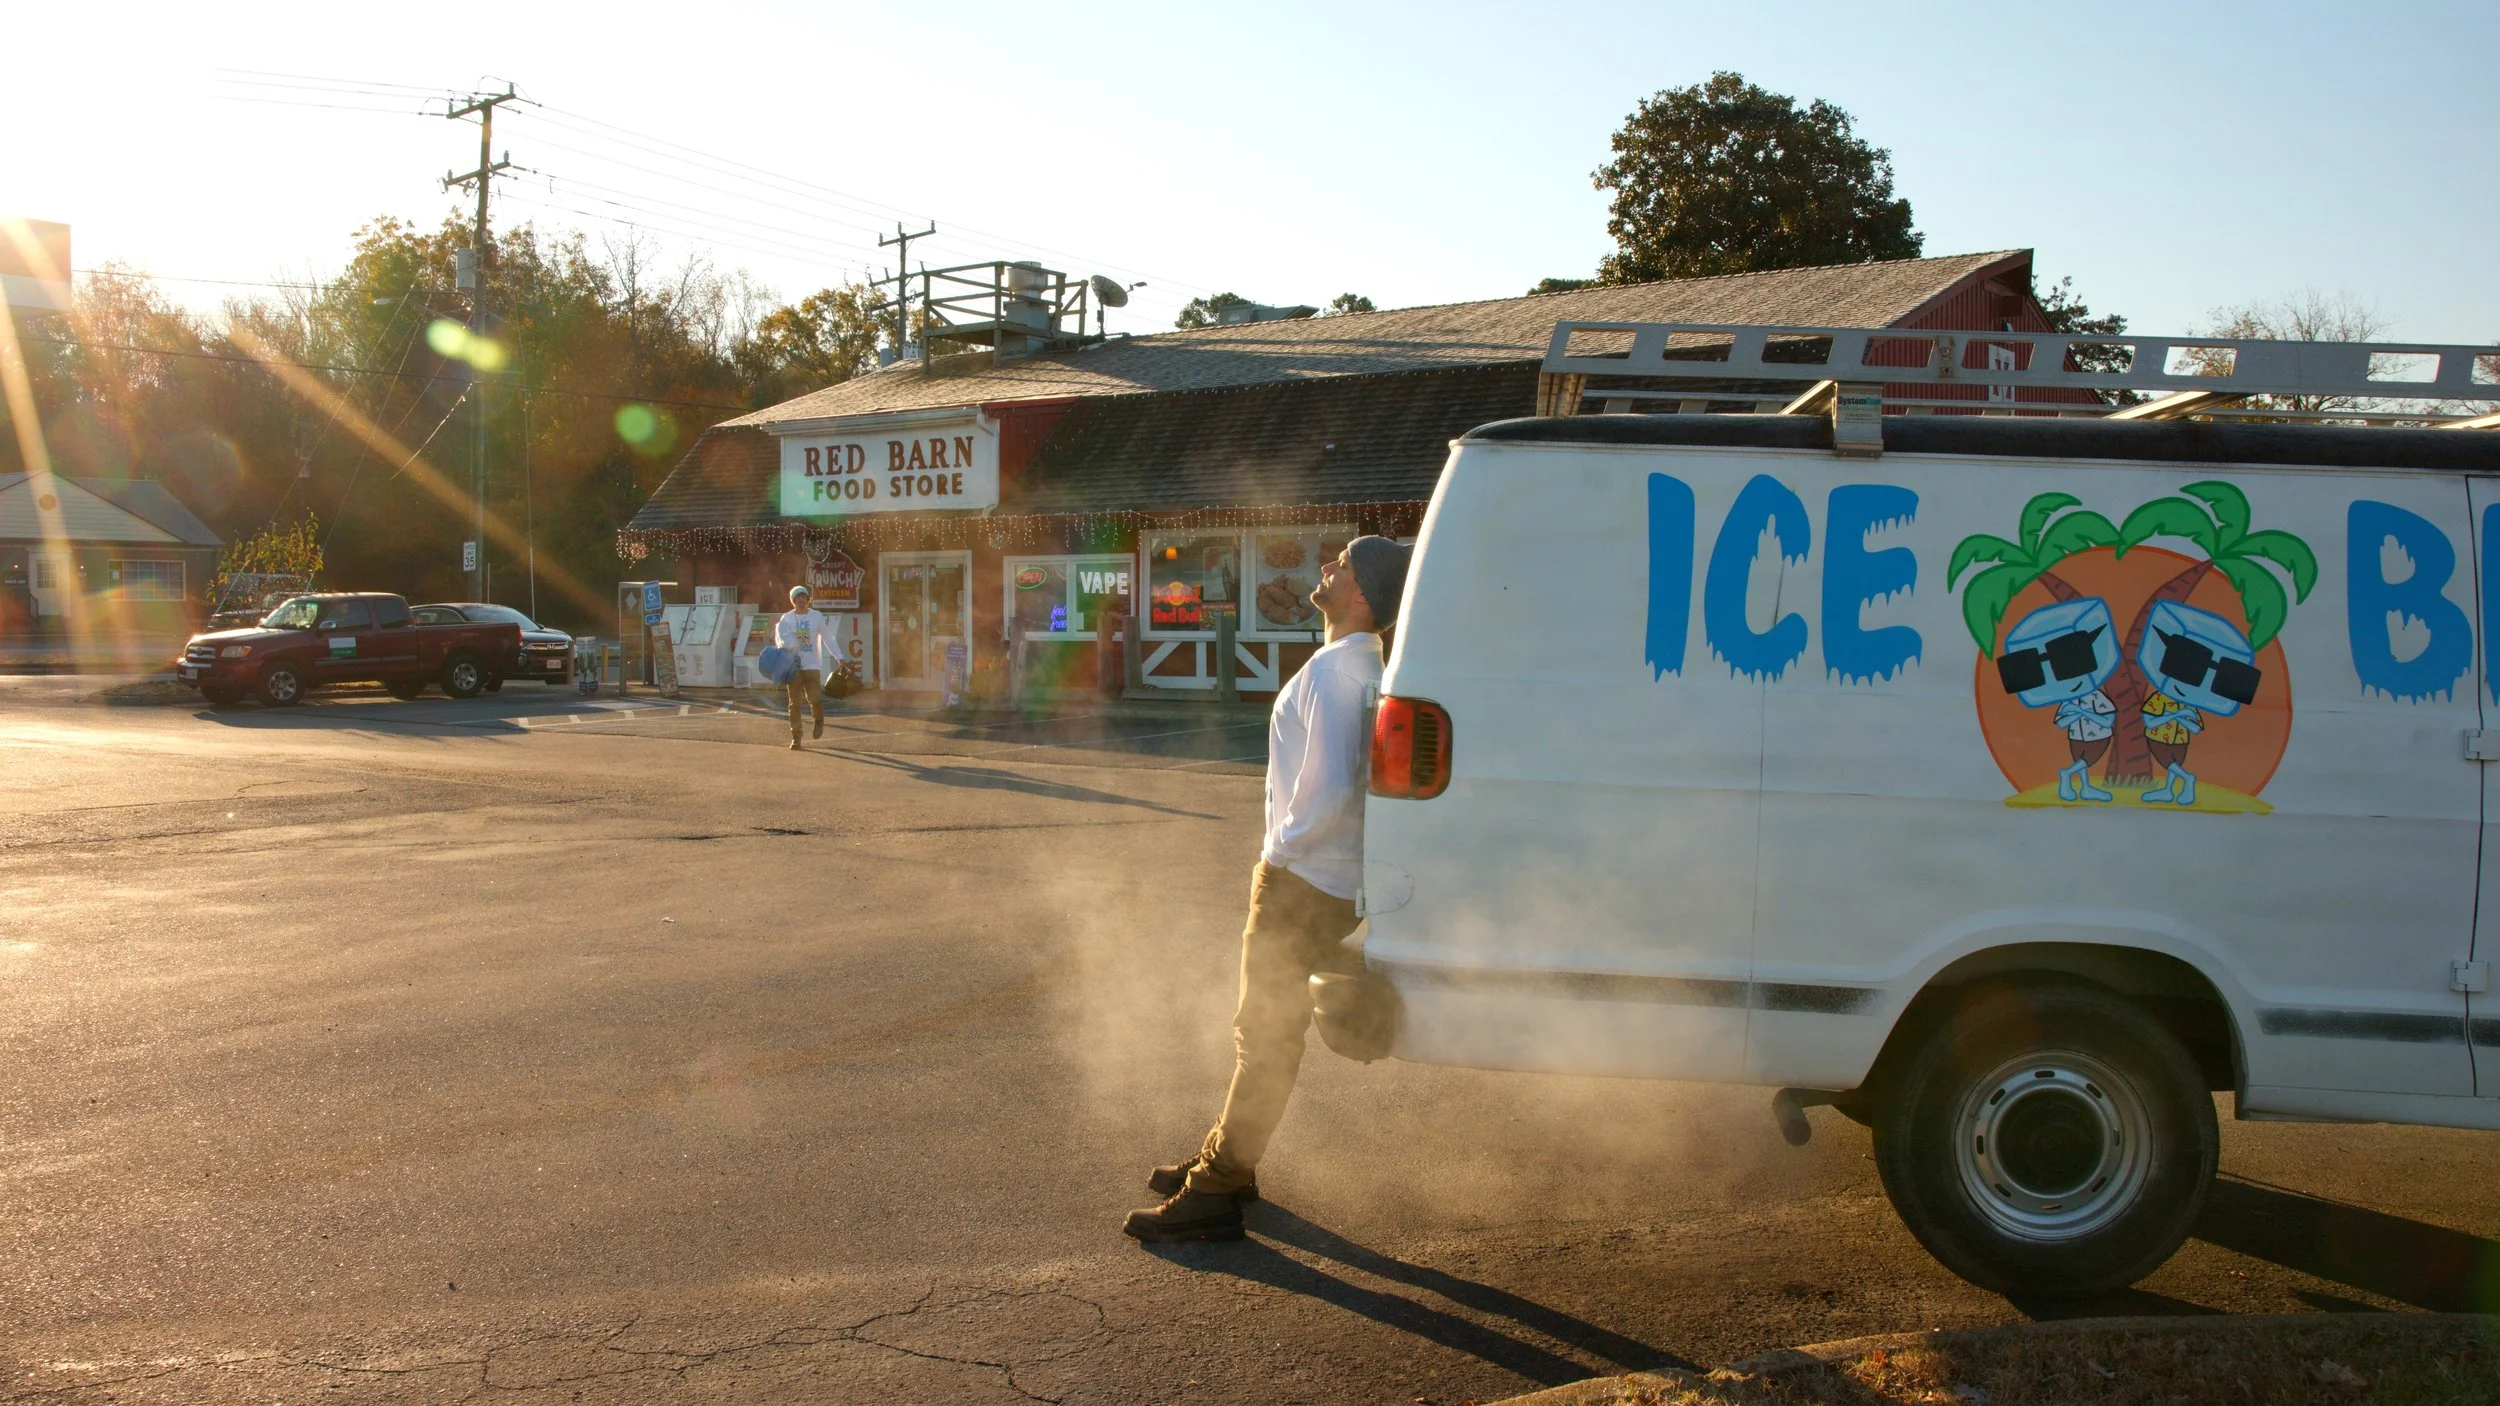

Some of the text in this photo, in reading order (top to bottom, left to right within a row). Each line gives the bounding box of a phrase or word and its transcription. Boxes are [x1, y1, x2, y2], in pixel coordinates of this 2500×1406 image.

[804, 436, 974, 476] RED BARN
[813, 472, 963, 501] FOOD STORE
[465, 556, 475, 568] 35
[821, 561, 846, 569] KRISPY
[807, 568, 862, 588] KRUNCHY
[1016, 570, 1043, 584] OPEN
[1080, 571, 1128, 595] VAPE
[819, 589, 851, 597] CHICKEN
[1645, 472, 2500, 707] ICE B
[700, 594, 714, 603] ICE
[1152, 606, 1177, 623] Red
[1178, 606, 1200, 623] Bull
